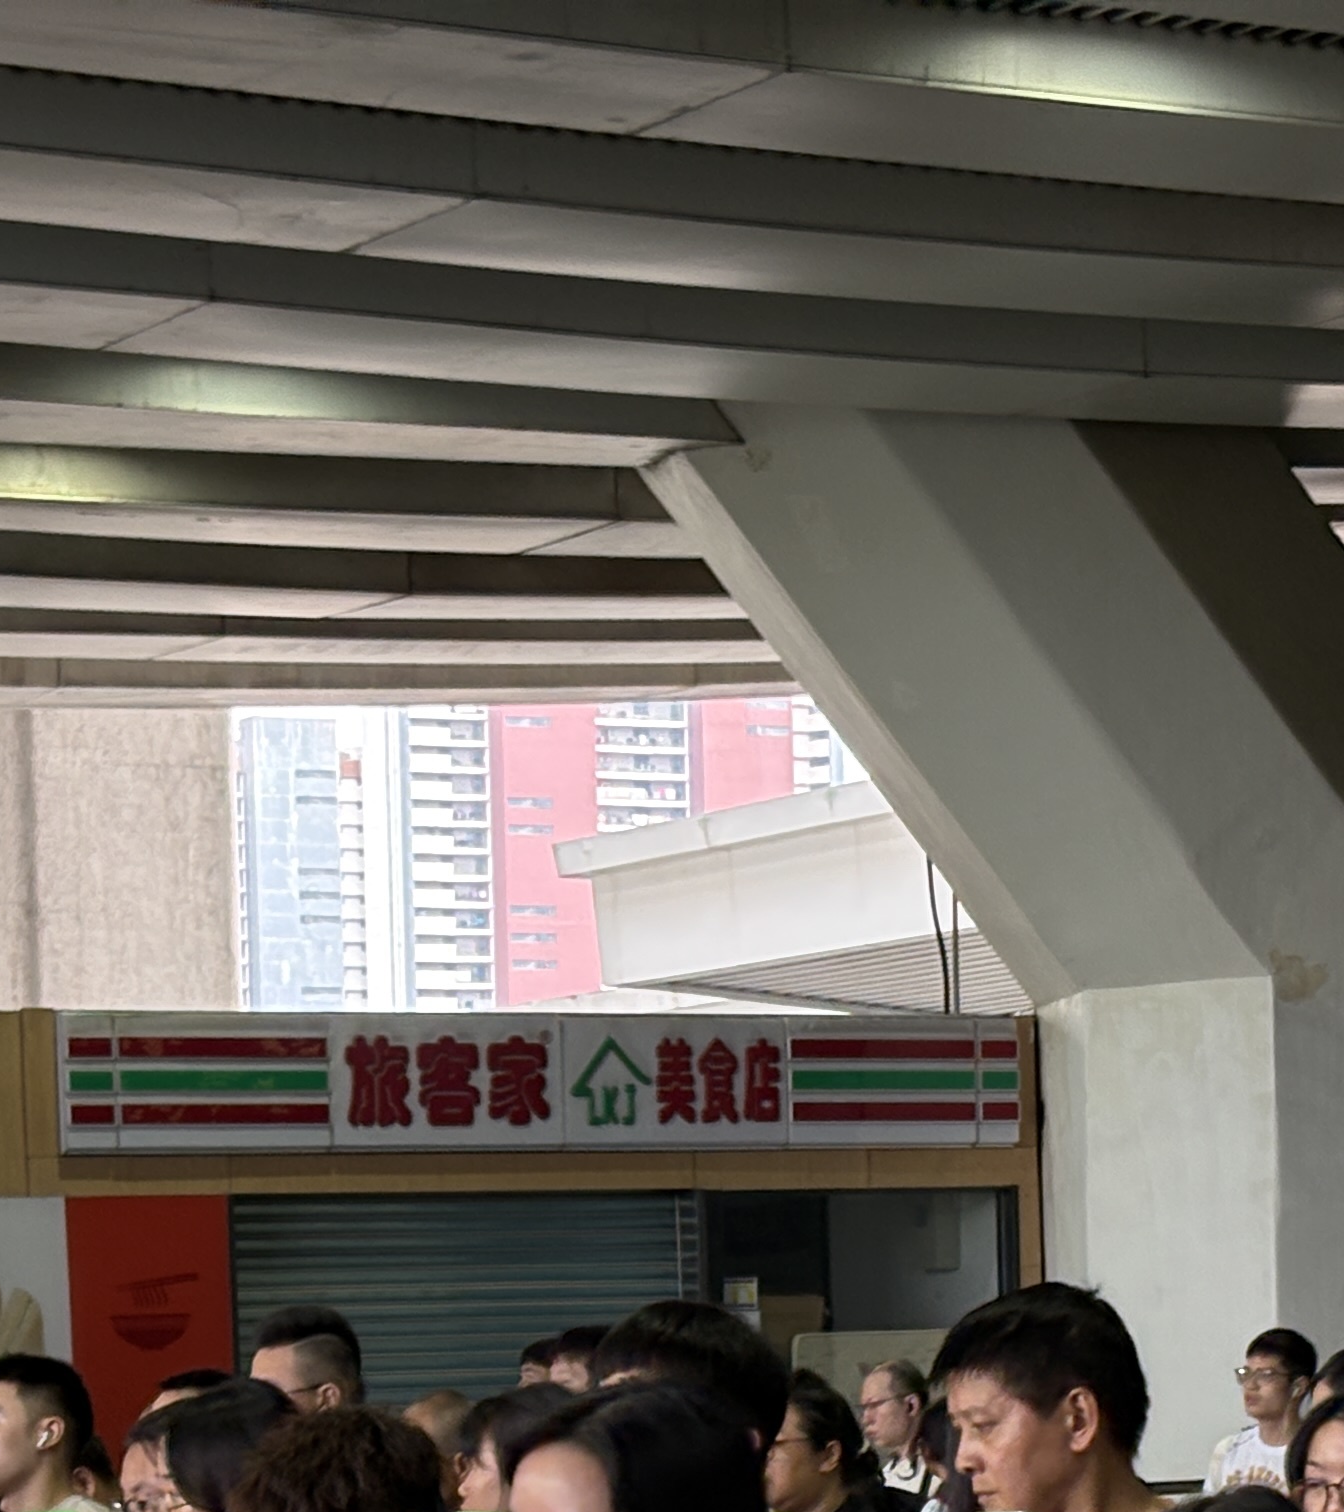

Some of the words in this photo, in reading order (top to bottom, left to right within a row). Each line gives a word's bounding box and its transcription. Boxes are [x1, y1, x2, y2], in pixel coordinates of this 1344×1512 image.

[345, 1035, 553, 1128] 旅客家
[655, 1037, 781, 1124] 美食店
